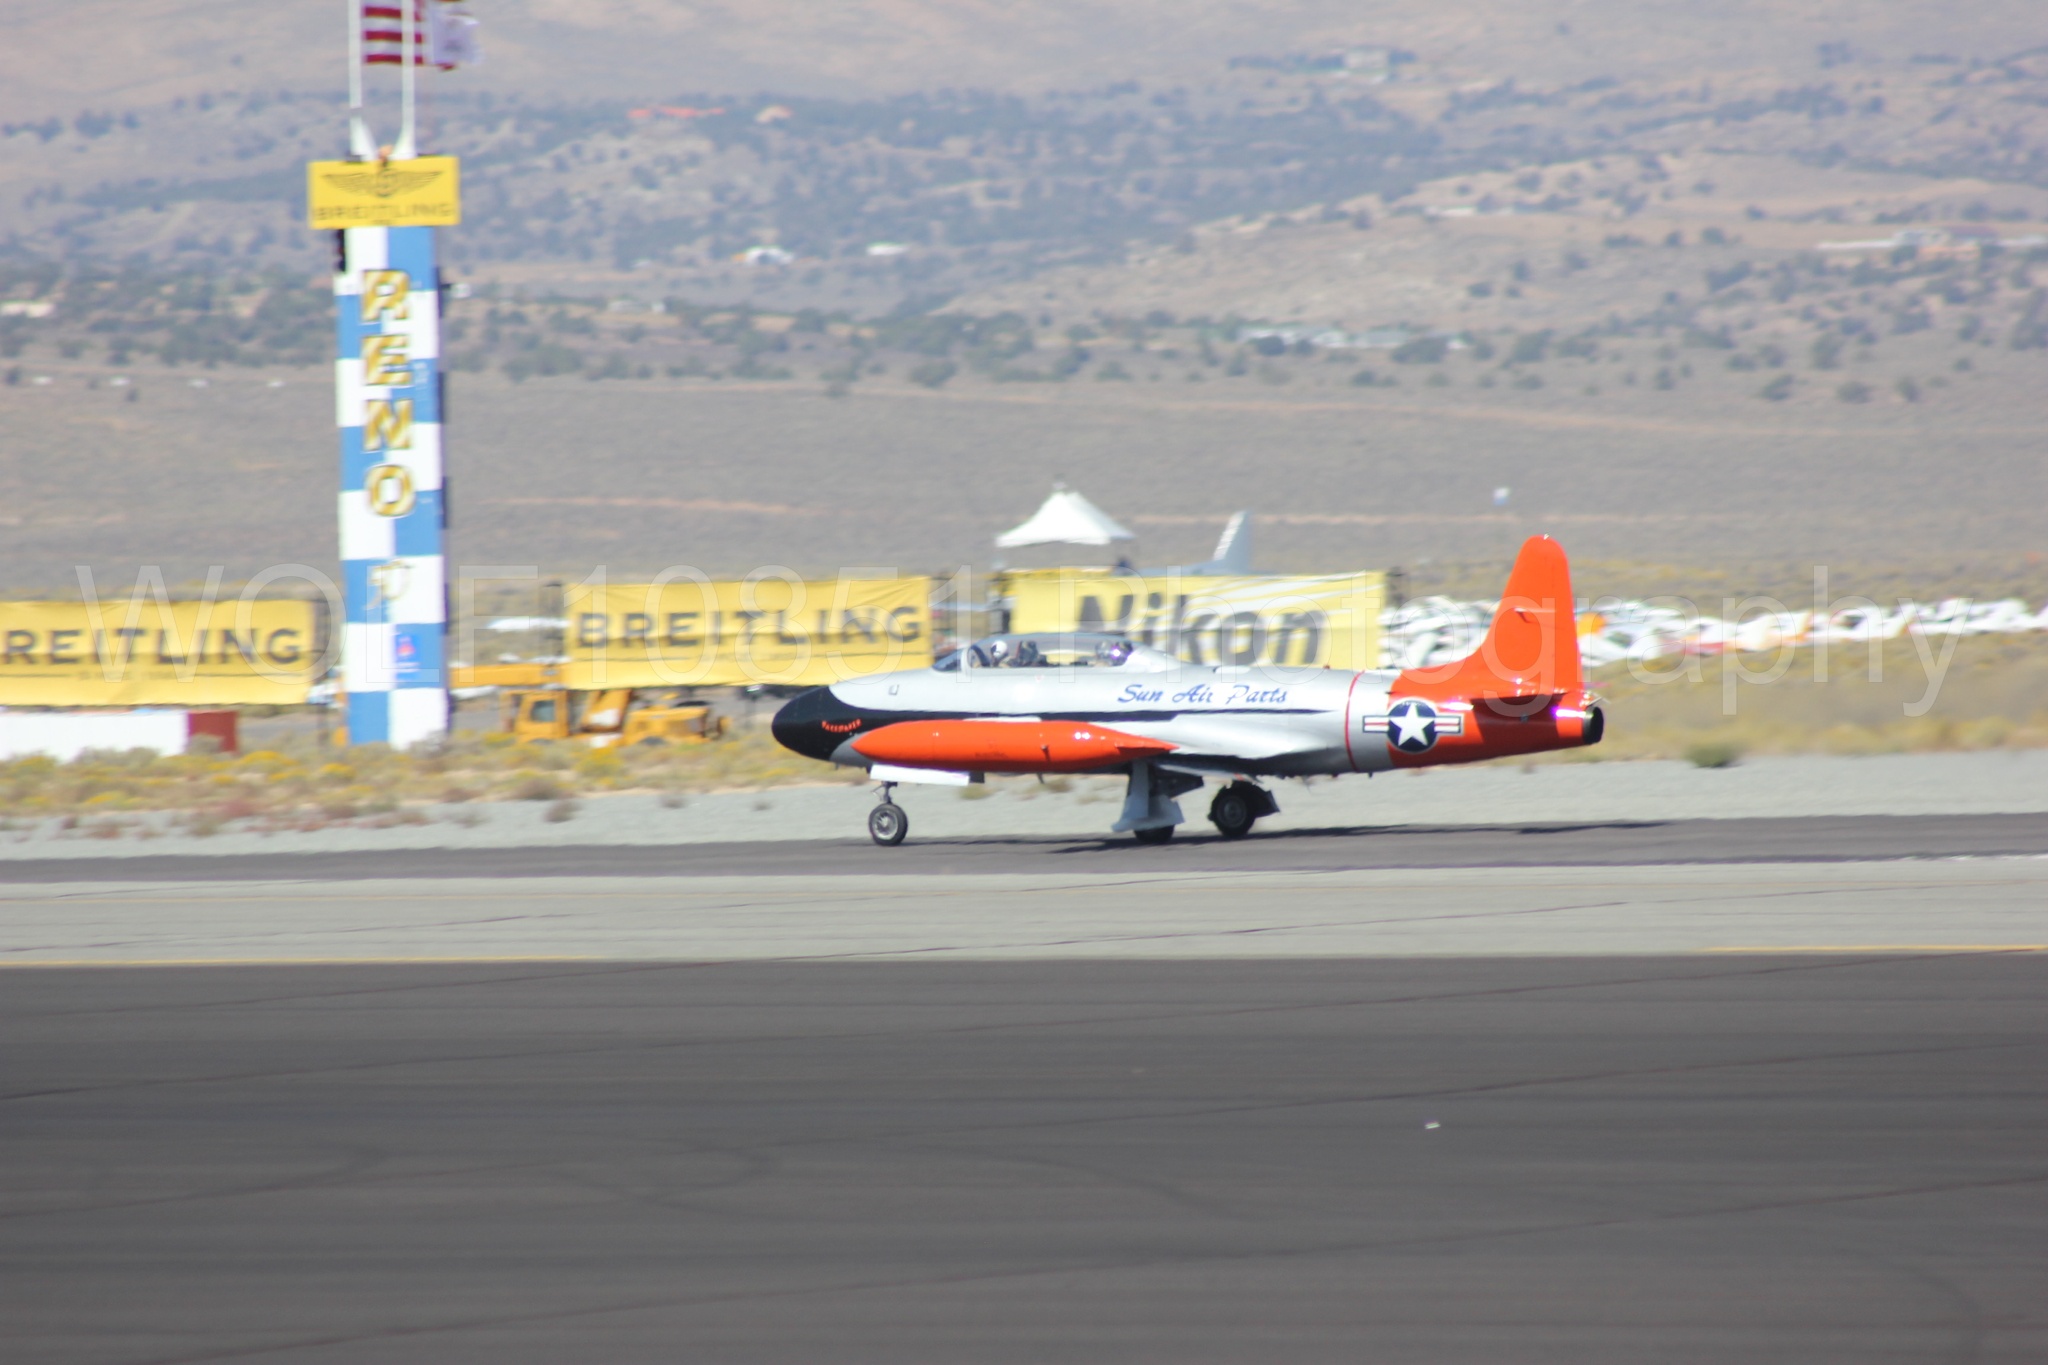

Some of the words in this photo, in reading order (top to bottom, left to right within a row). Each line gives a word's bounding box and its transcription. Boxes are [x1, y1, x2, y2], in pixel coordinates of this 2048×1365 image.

[361, 269, 416, 518] RENO
[576, 606, 922, 648] BREITLING
[1077, 592, 1326, 666] Nikon
[1117, 684, 1164, 703] Sun
[1172, 683, 1213, 703] Air
[1225, 685, 1288, 704] Parts
